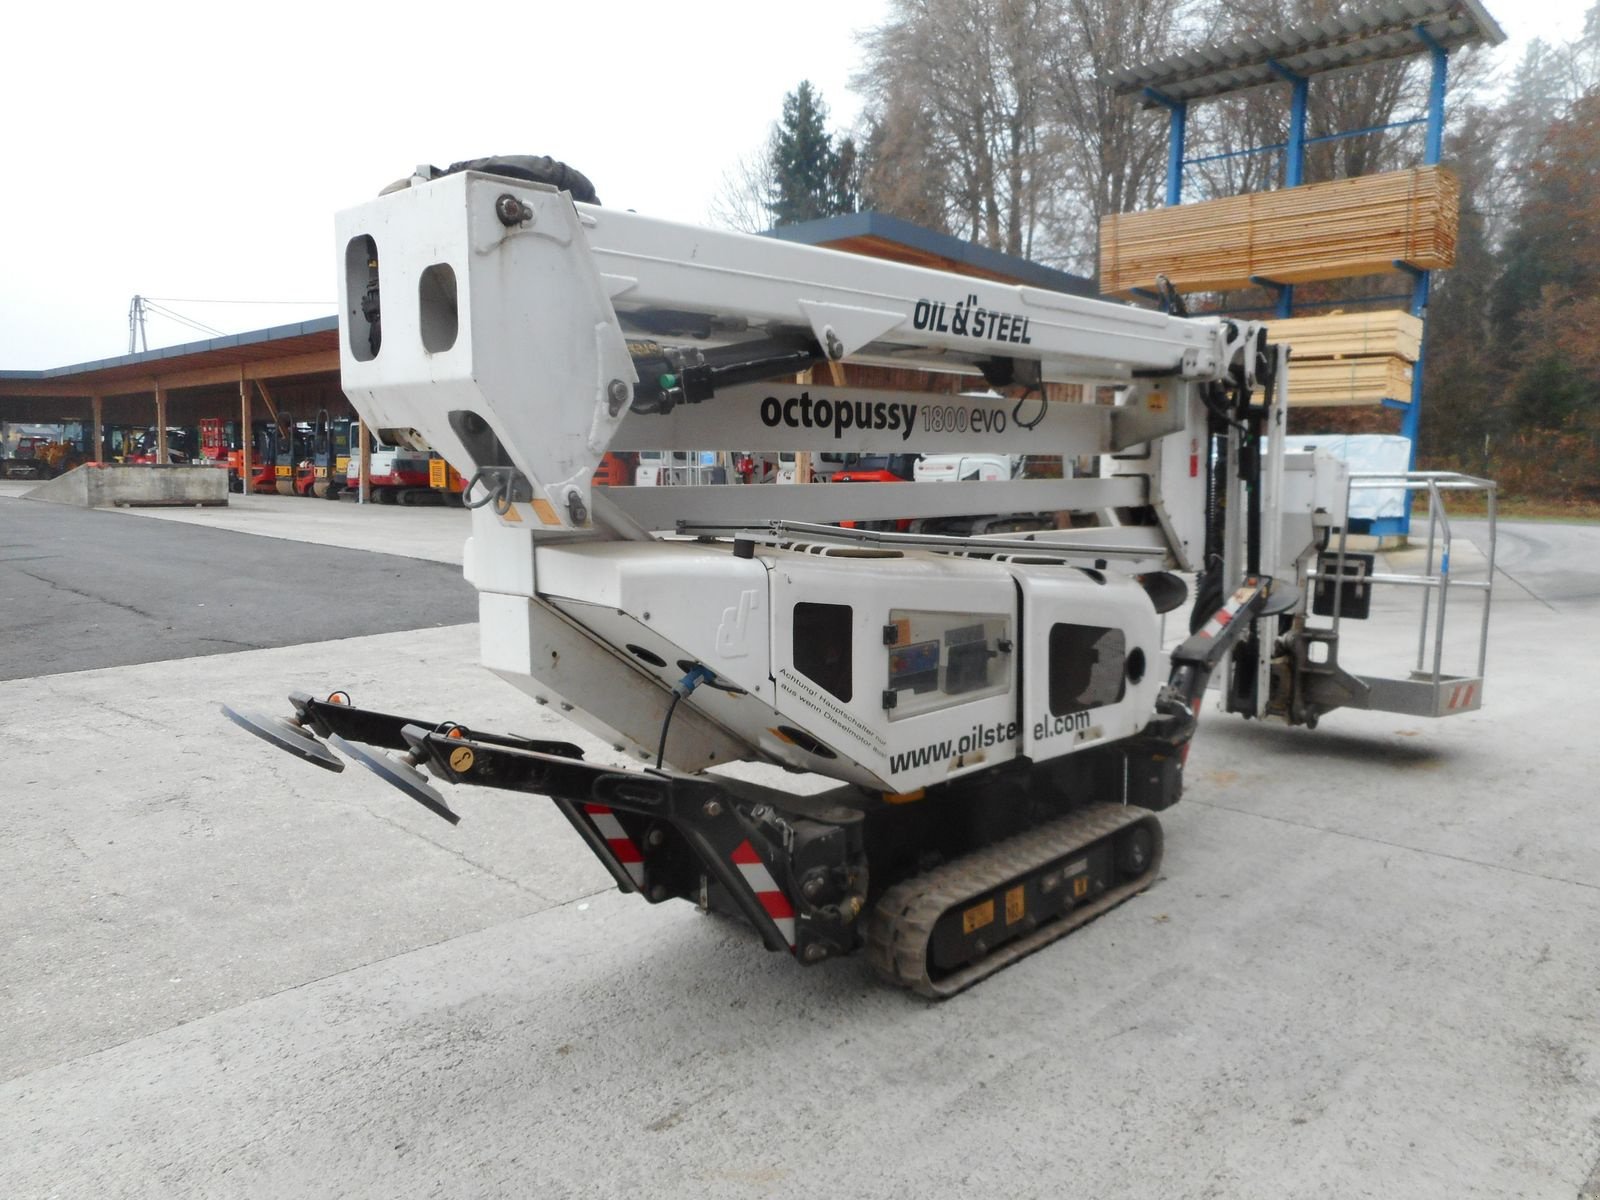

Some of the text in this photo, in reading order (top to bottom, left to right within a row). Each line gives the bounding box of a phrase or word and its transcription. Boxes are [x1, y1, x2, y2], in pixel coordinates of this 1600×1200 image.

[913, 298, 948, 332] OIL
[973, 311, 1032, 345] STEEL
[760, 391, 1007, 441] octopussy 1800 evo
[779, 668, 818, 696] Achtung!
[819, 695, 875, 736] Hauptschalter
[780, 683, 872, 747] aus wenn Dieselmotor
